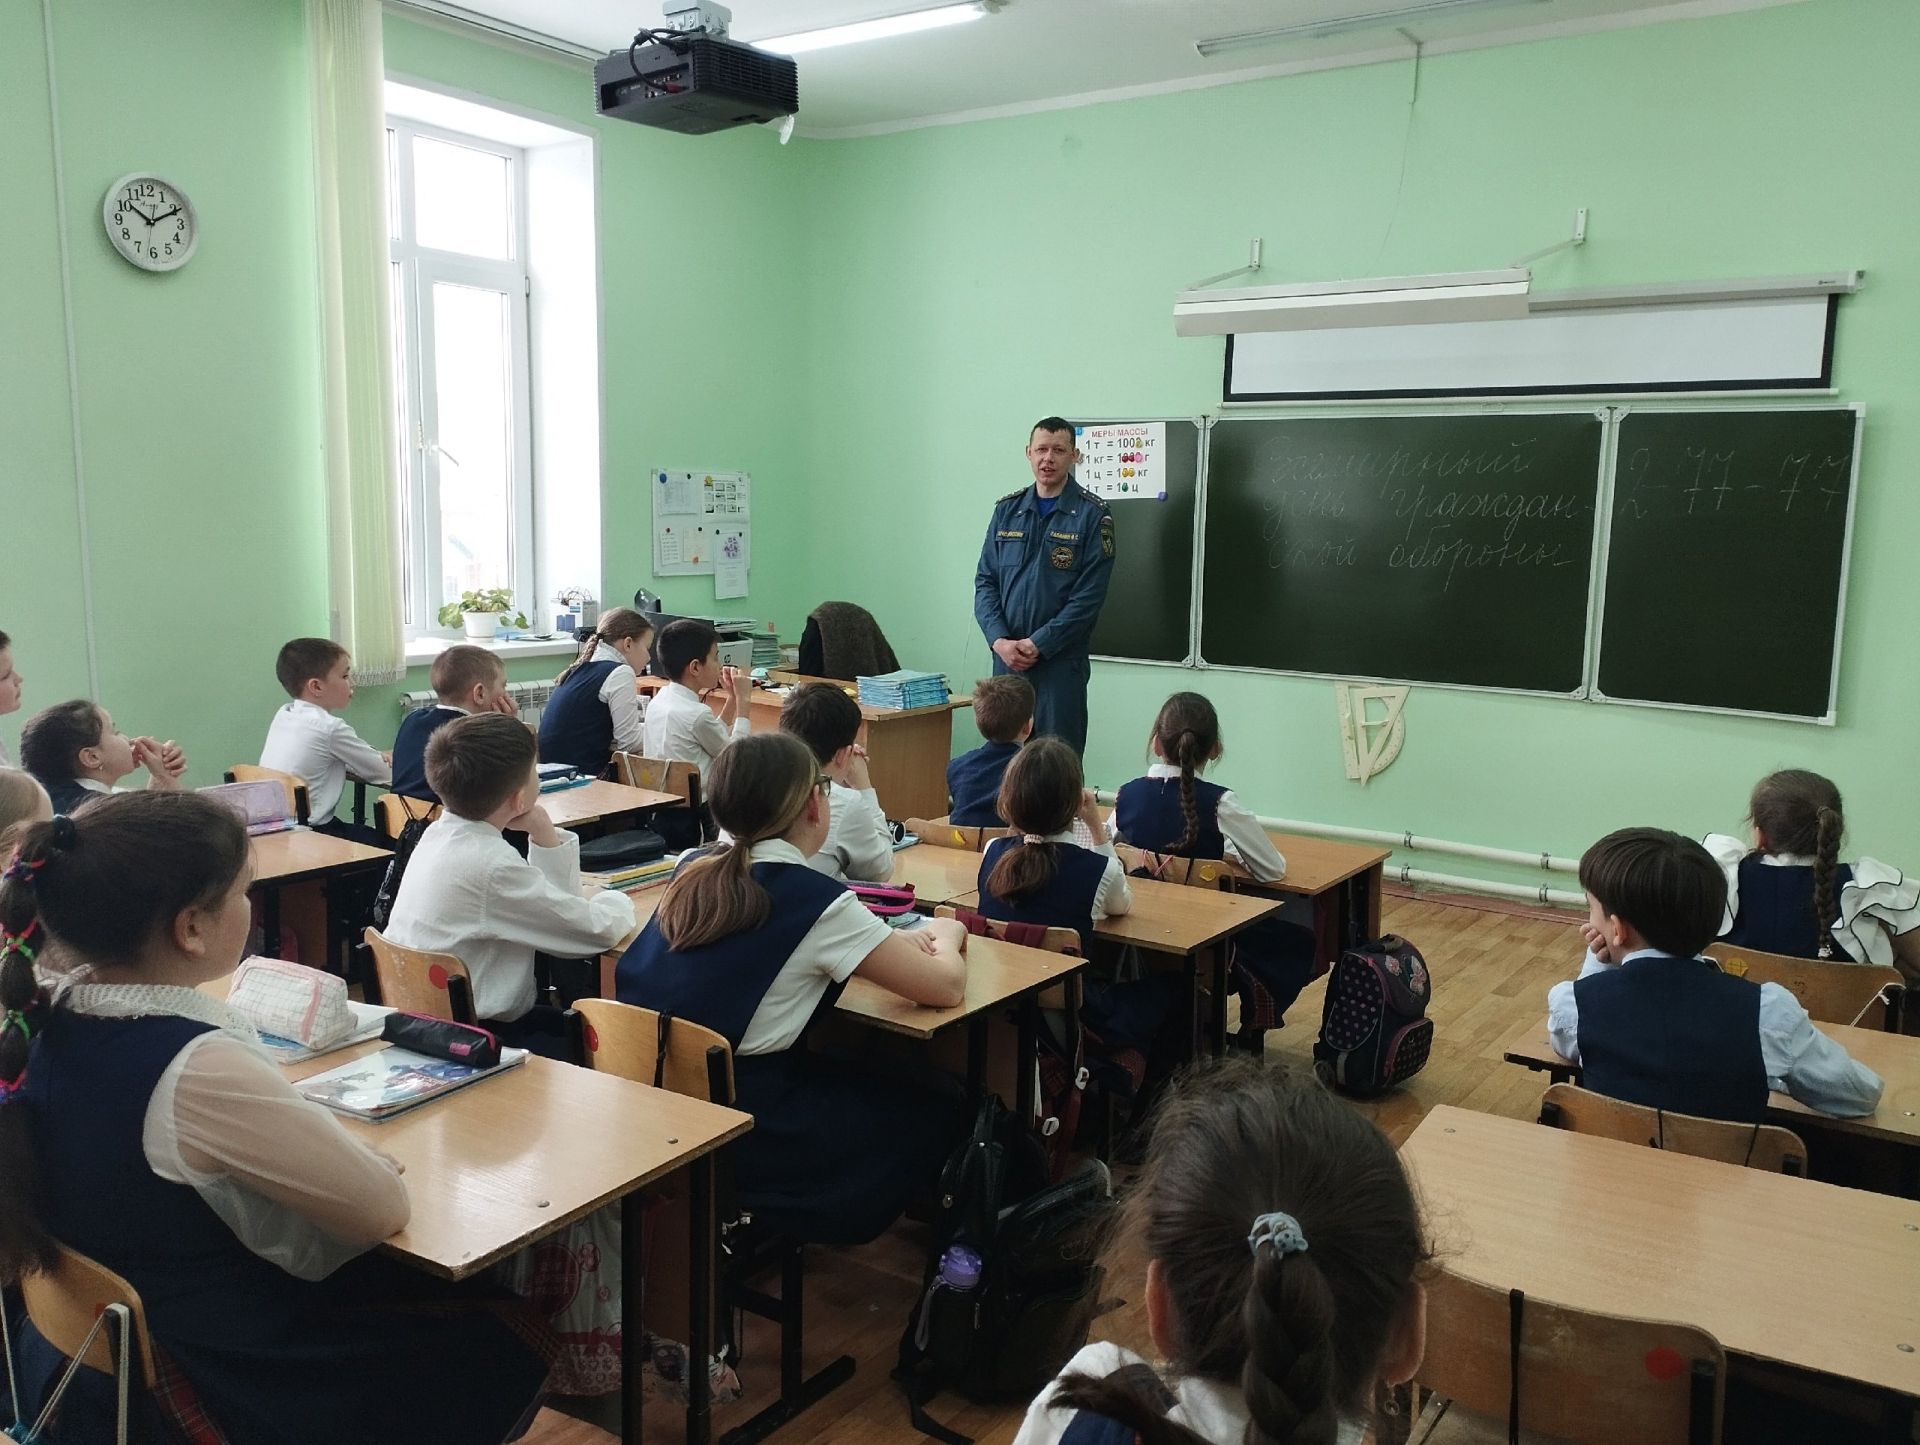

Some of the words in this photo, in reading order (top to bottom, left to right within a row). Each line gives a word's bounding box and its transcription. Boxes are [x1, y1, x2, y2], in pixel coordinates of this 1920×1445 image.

[126, 189, 140, 201] 11
[139, 184, 154, 197] 12
[159, 191, 165, 203] 1
[117, 200, 132, 212] 10
[114, 213, 123, 225] 9
[177, 219, 184, 230] 3
[122, 228, 130, 240] 8
[173, 232, 180, 244] 4
[135, 241, 142, 253] 7
[150, 247, 158, 259] 6
[165, 243, 173, 255] 5
[1118, 428, 1148, 436] МАССЫ
[1086, 440, 1090, 450] 1
[1145, 439, 1155, 447] кг
[1086, 455, 1090, 464] 1
[1094, 456, 1104, 464] кг
[1086, 470, 1090, 479] 1
[1132, 484, 1139, 492] ц
